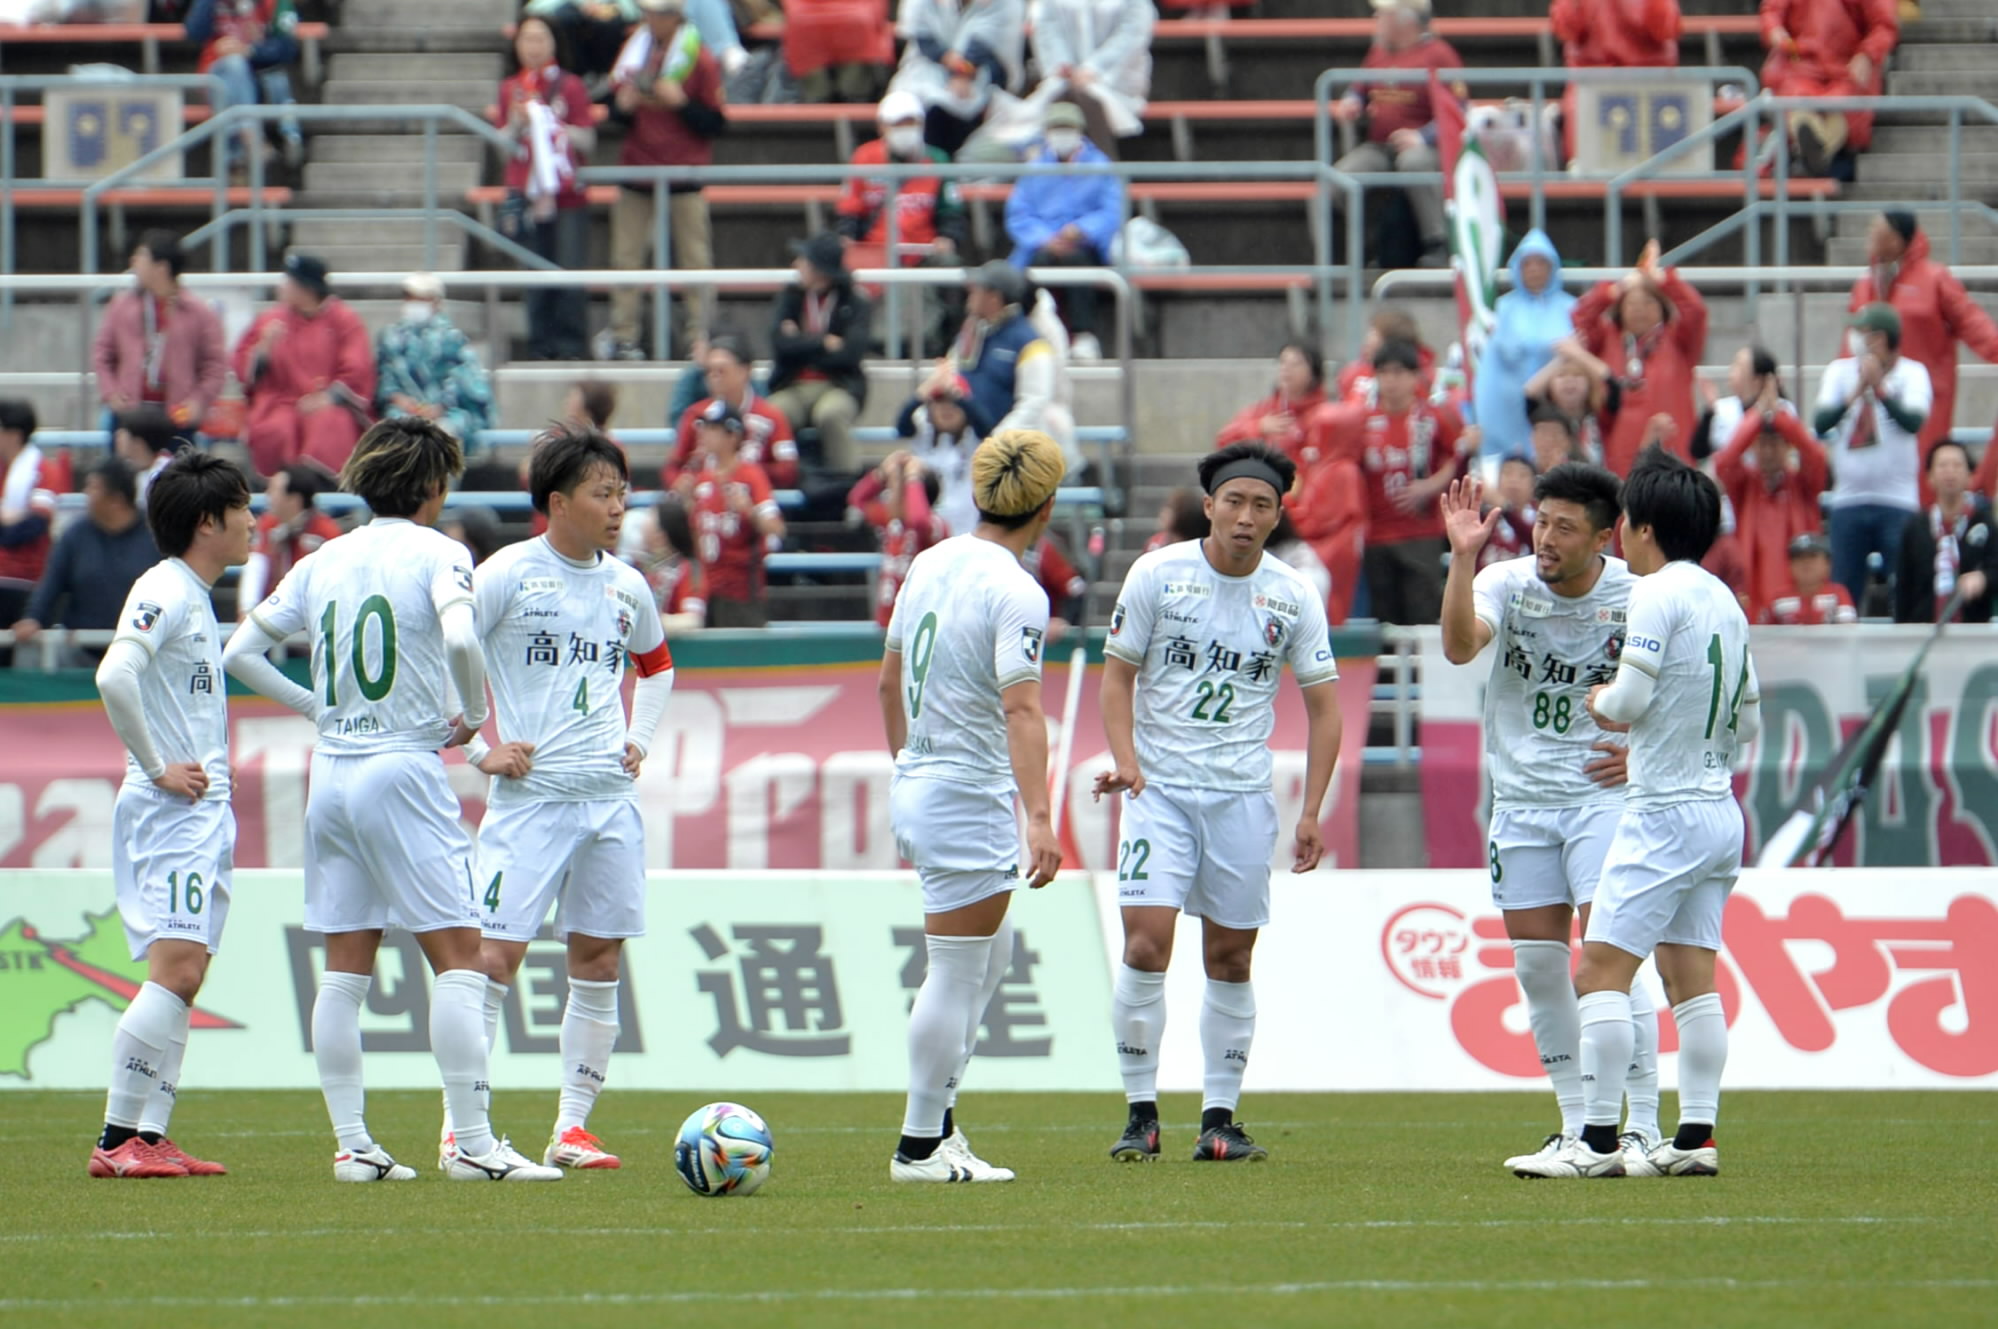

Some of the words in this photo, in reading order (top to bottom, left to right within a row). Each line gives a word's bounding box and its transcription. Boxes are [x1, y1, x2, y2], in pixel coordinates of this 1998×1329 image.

[523, 607, 559, 618] ATHLETA
[320, 593, 398, 707] 10
[526, 629, 625, 675] 高知家
[908, 611, 937, 719] 9
[1163, 635, 1277, 682] 高知家
[573, 676, 589, 716] 4
[1191, 680, 1235, 723] 22
[1533, 691, 1572, 734] 88
[335, 716, 380, 736] TAIGA
[1119, 838, 1151, 881] 22
[167, 870, 204, 915] 16
[483, 871, 503, 913] 4
[167, 919, 201, 930] ATHLETA
[1395, 929, 1470, 954] タウン
